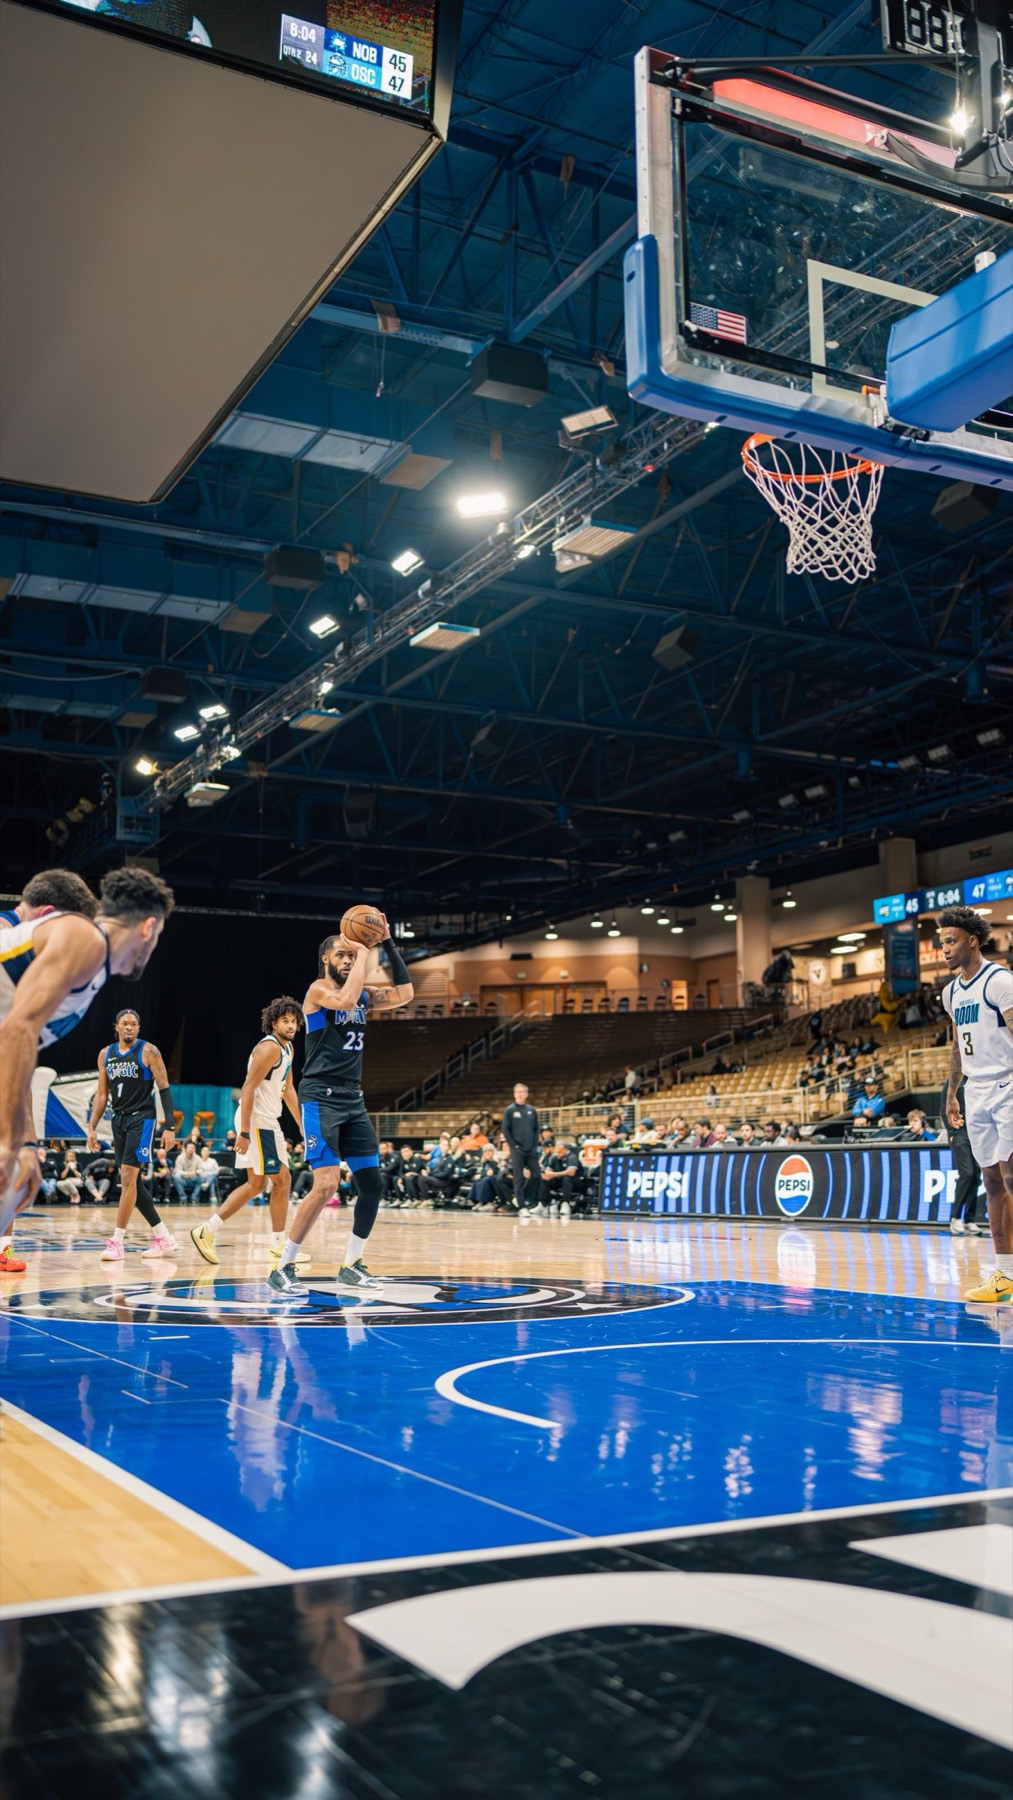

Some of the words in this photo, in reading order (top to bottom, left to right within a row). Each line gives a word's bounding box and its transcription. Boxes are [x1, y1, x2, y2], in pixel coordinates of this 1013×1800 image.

[290, 22, 316, 43] 6:04
[305, 50, 318, 65] 24
[352, 42, 378, 64] NOB
[389, 54, 407, 73] 45
[351, 64, 376, 85] OSC
[388, 75, 405, 92] 47
[937, 888, 960, 906] 6:04
[972, 883, 986, 899] 47
[905, 898, 919, 914] 45
[335, 1008, 366, 1025] MAGI
[342, 1031, 365, 1051] 23
[962, 1031, 974, 1056] 3
[117, 1082, 124, 1098] 1
[626, 1171, 689, 1198] PEPSI
[778, 1179, 811, 1191] PEPSI
